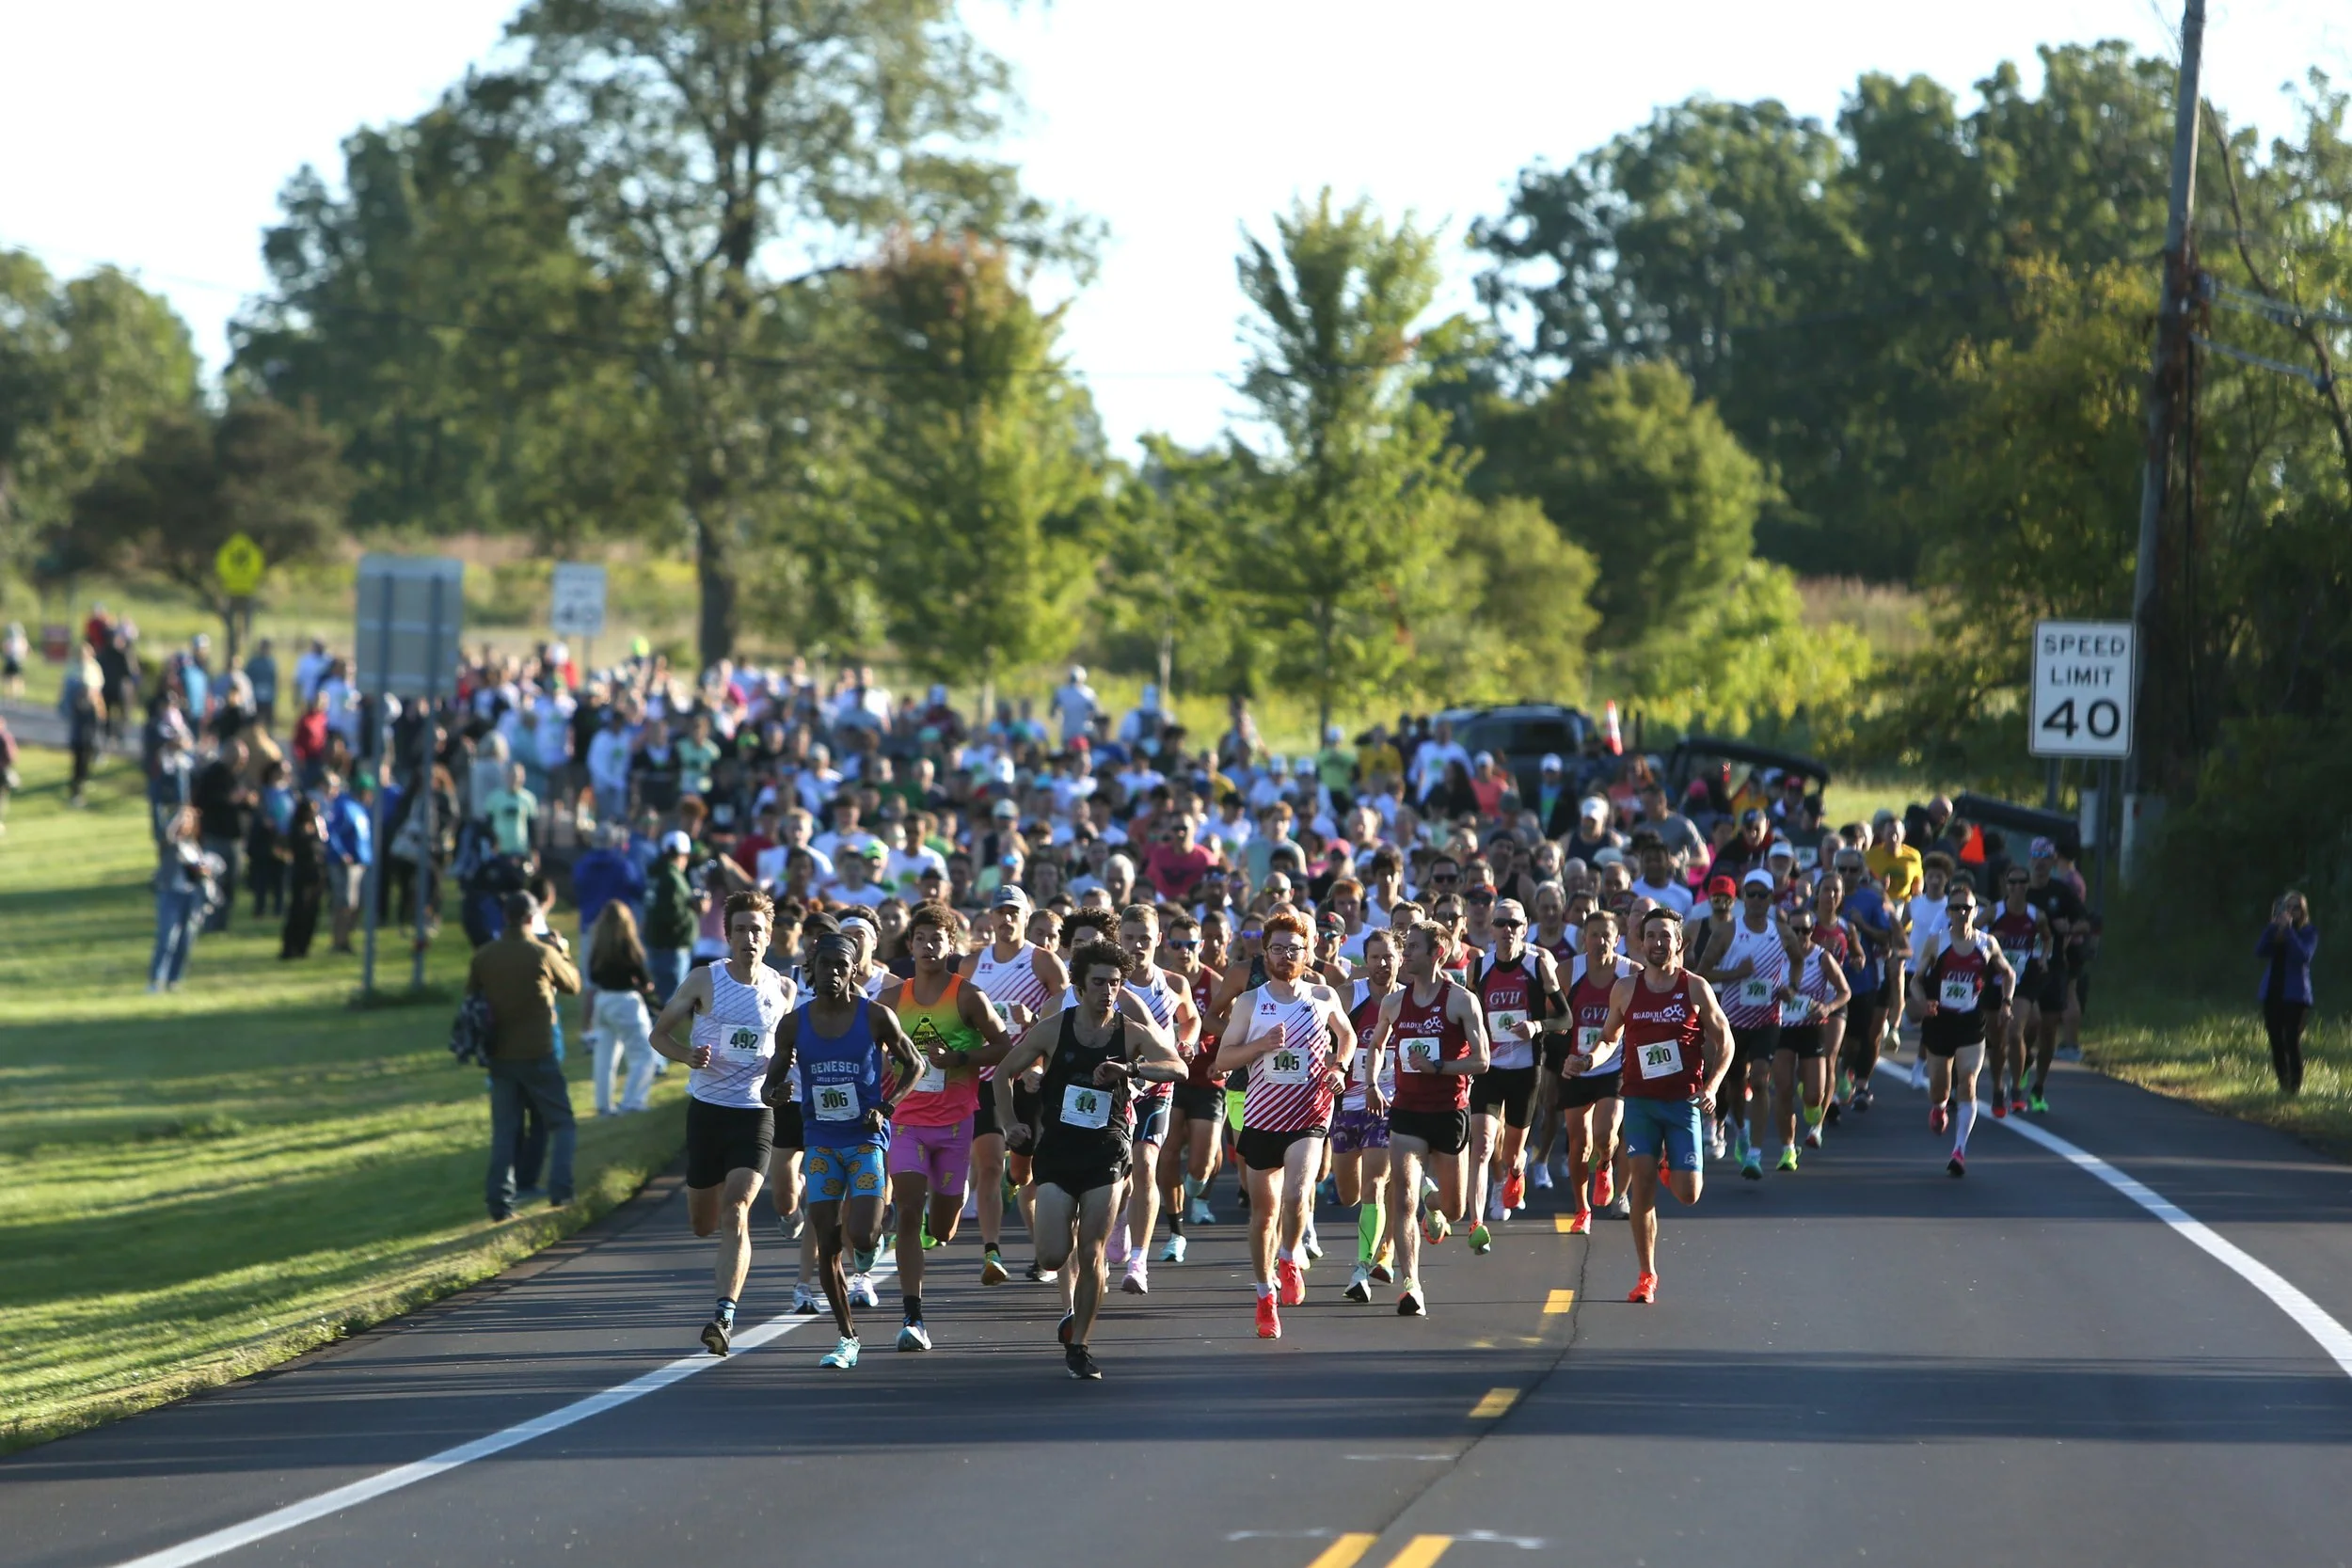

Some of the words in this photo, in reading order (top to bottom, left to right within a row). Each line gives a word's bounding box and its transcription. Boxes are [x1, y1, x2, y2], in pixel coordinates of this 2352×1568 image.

[2043, 634, 2125, 657] SPEED
[2050, 665, 2114, 687] LIMIT
[2042, 696, 2121, 739] 40
[1489, 990, 1520, 1005] GVH
[1632, 1011, 1662, 1020] ROADKILL
[729, 1032, 759, 1049] 492
[1273, 1055, 1300, 1070] 145
[1645, 1048, 1672, 1066] 210
[810, 1060, 860, 1074] GENESEO
[820, 1091, 849, 1108] 306
[1077, 1095, 1097, 1115] 14
